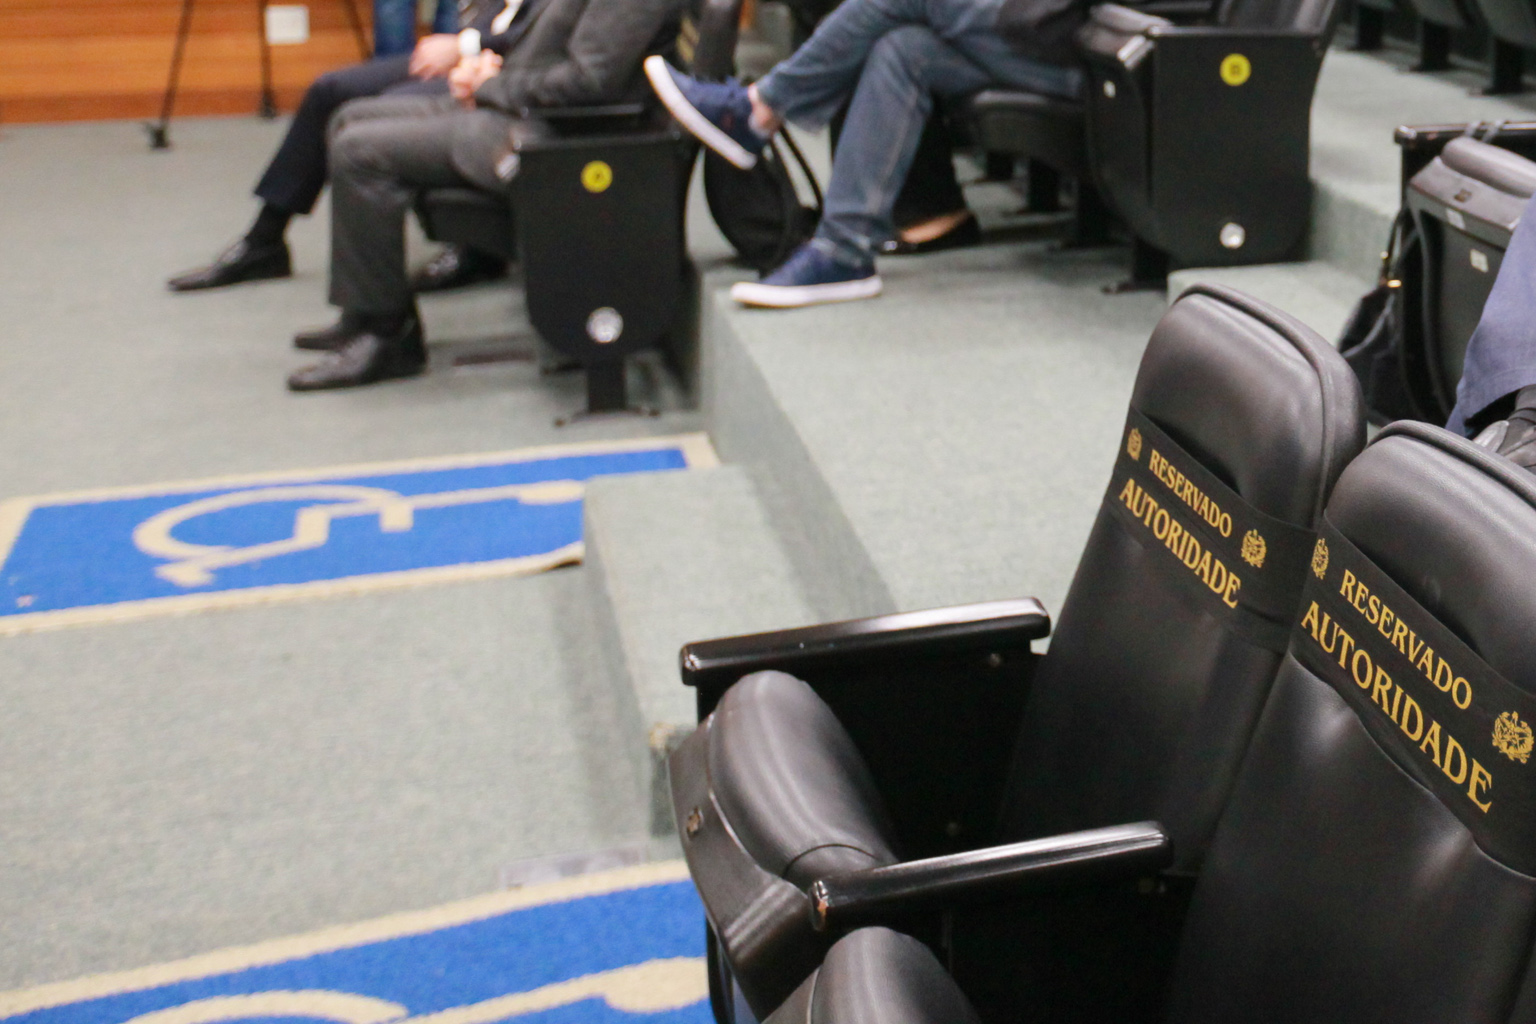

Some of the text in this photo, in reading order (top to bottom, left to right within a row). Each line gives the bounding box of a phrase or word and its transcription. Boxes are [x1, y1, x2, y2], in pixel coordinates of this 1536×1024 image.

[1118, 478, 1242, 609] AUTORIDADE
[1148, 448, 1233, 538] RESERVADO
[1300, 600, 1493, 814] AUTORIDADE
[1338, 569, 1473, 710] RESERVADO
